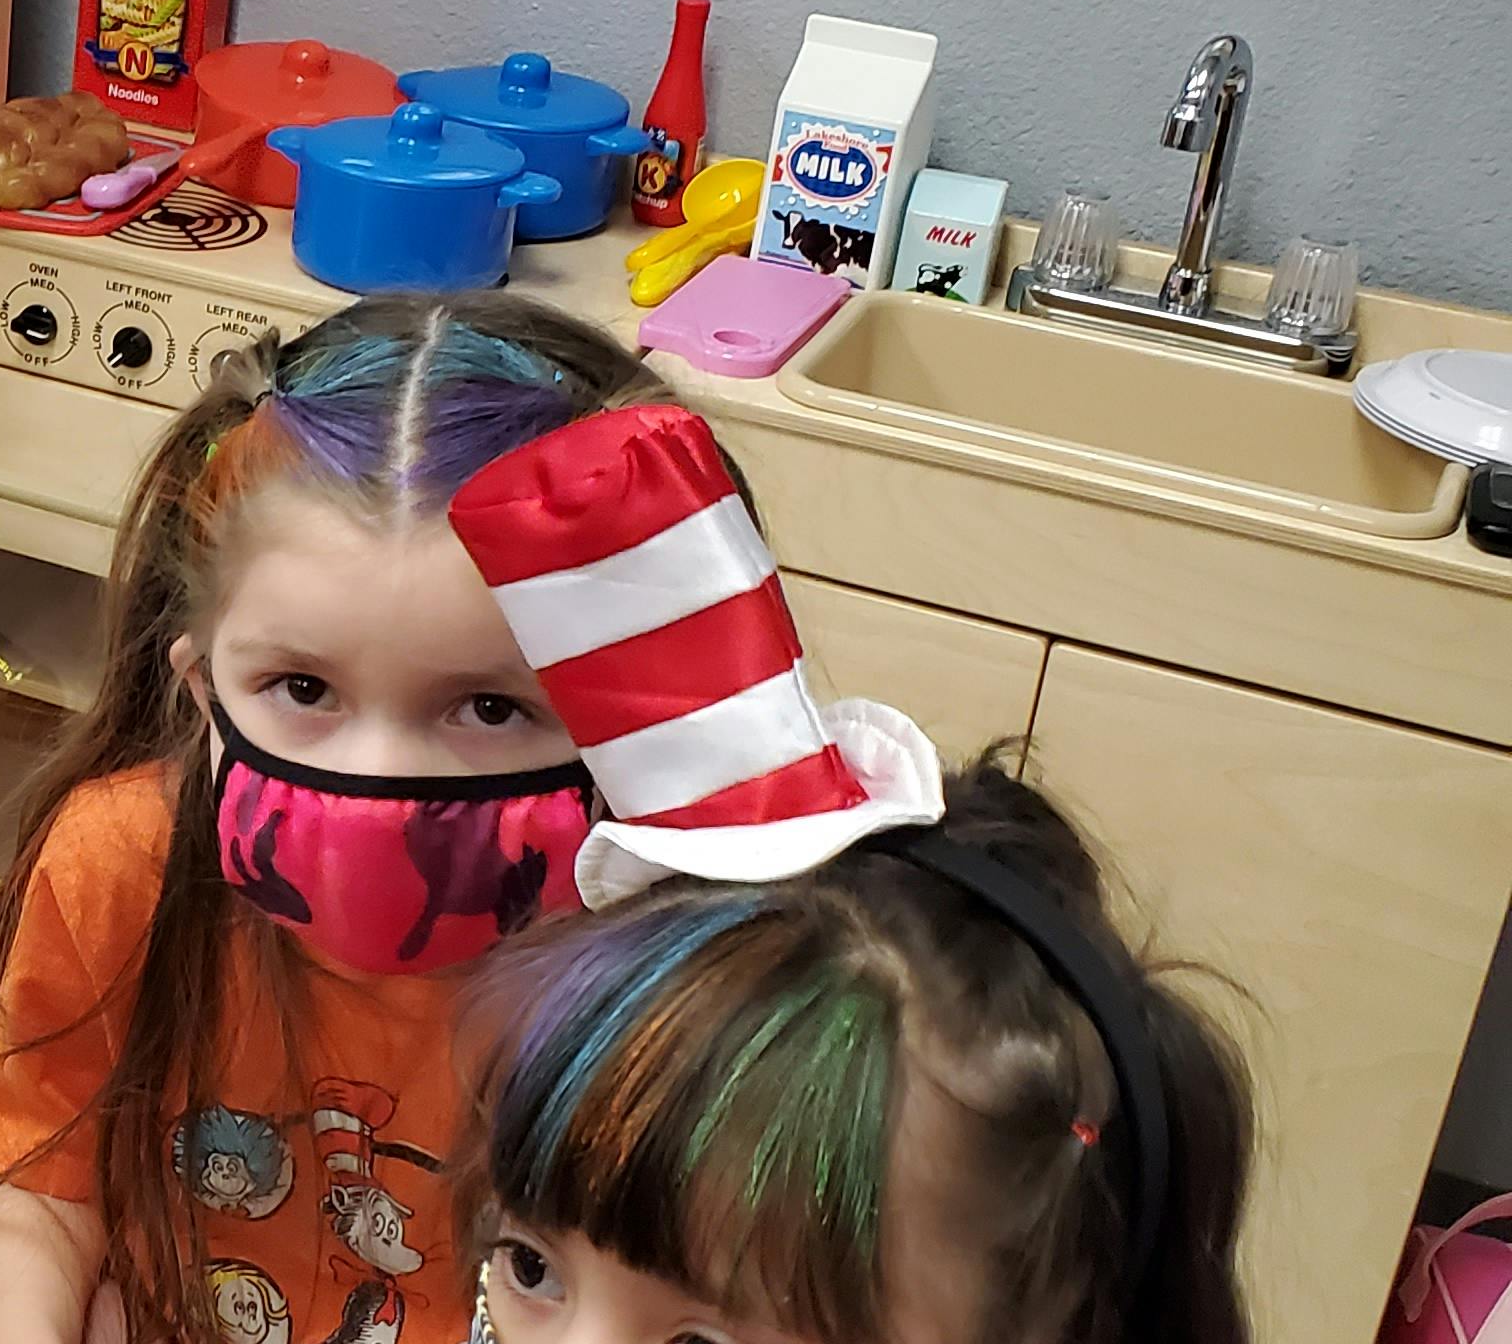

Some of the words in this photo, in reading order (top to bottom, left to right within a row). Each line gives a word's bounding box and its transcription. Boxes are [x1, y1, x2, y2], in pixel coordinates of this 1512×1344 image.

[125, 47, 148, 76] N
[108, 82, 159, 106] Noodles
[805, 129, 870, 149] Lakeshore
[641, 163, 659, 190] K
[795, 151, 867, 187] MILK
[925, 225, 977, 249] MILK
[28, 262, 59, 279] OVEN
[29, 277, 56, 292] MED
[105, 280, 135, 296] LEFT
[135, 287, 173, 305] FRONT
[0, 299, 10, 329] LOW
[124, 299, 151, 315] MED
[206, 303, 234, 319] LEFT
[236, 309, 269, 327] REAR
[69, 314, 81, 347] HIGH
[92, 321, 105, 352] LOW
[221, 321, 249, 337] MED
[23, 352, 51, 368] OFF
[165, 337, 177, 370] HIGH
[187, 344, 201, 374] LOW
[117, 375, 144, 391] OFF
